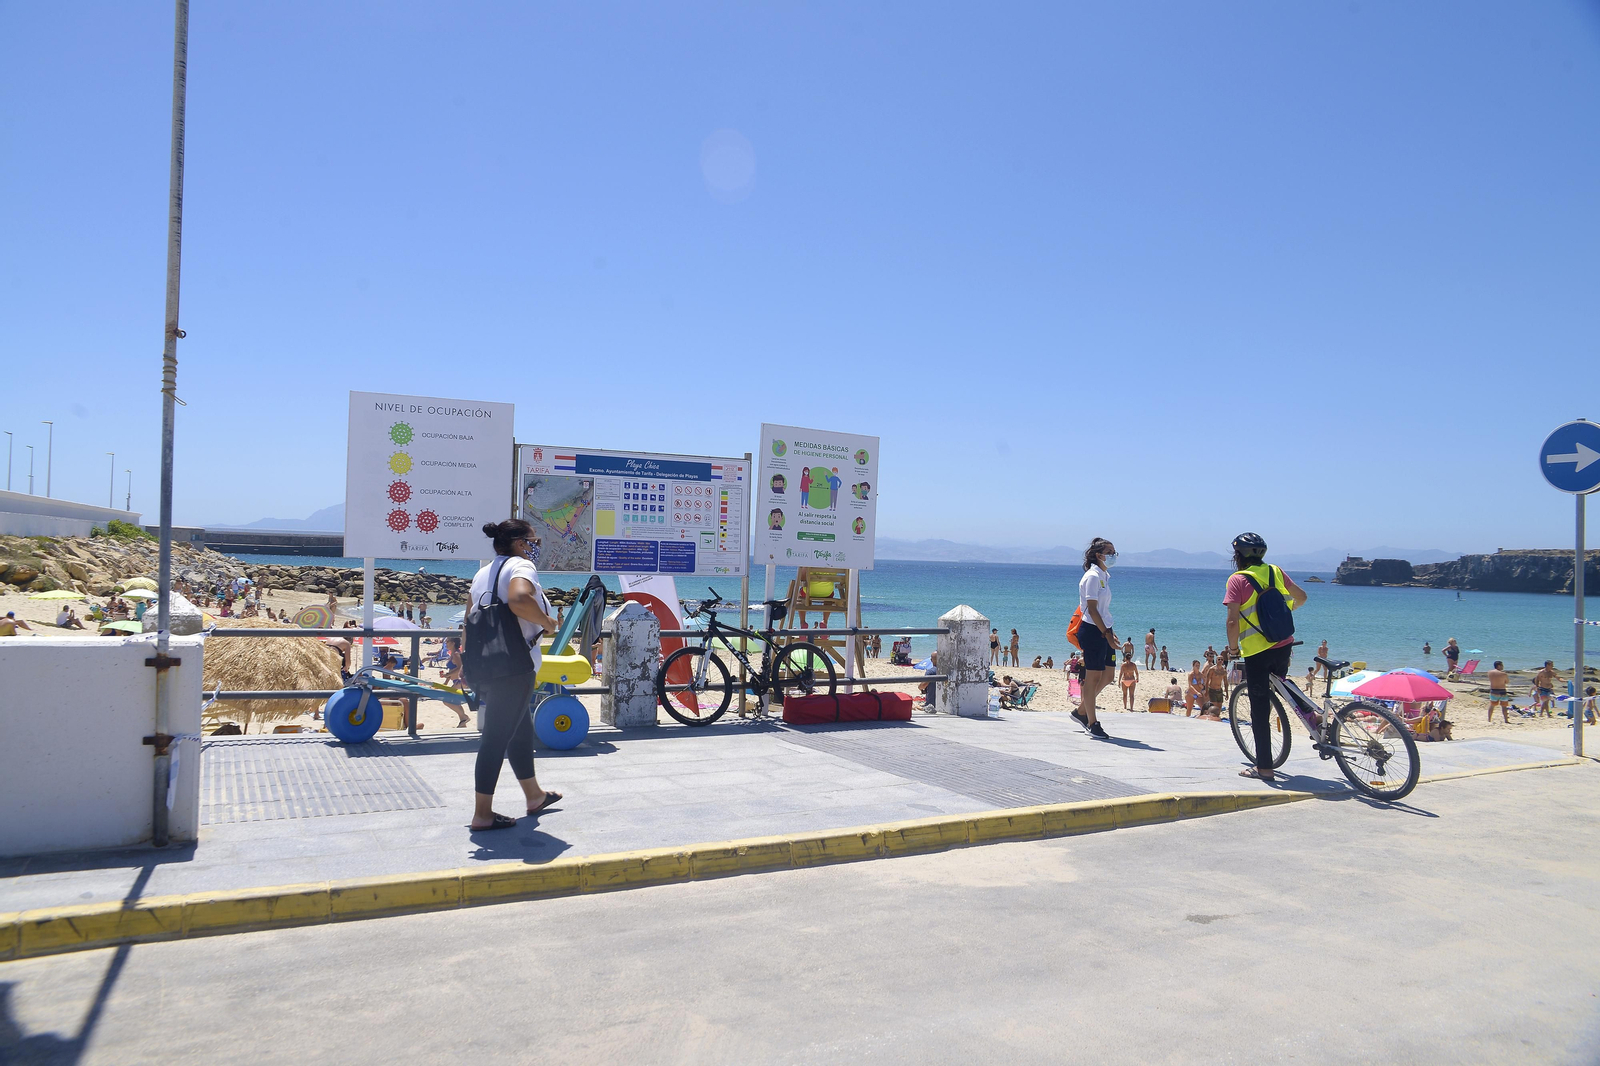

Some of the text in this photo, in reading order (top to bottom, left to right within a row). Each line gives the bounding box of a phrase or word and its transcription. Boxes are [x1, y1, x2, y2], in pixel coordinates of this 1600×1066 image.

[375, 402, 492, 418] NIVEL DE OCUPACIÓN
[794, 441, 849, 452] MEDIDAS BÁSICAS
[644, 461, 659, 470] Chica
[436, 541, 459, 553] Tarifa
